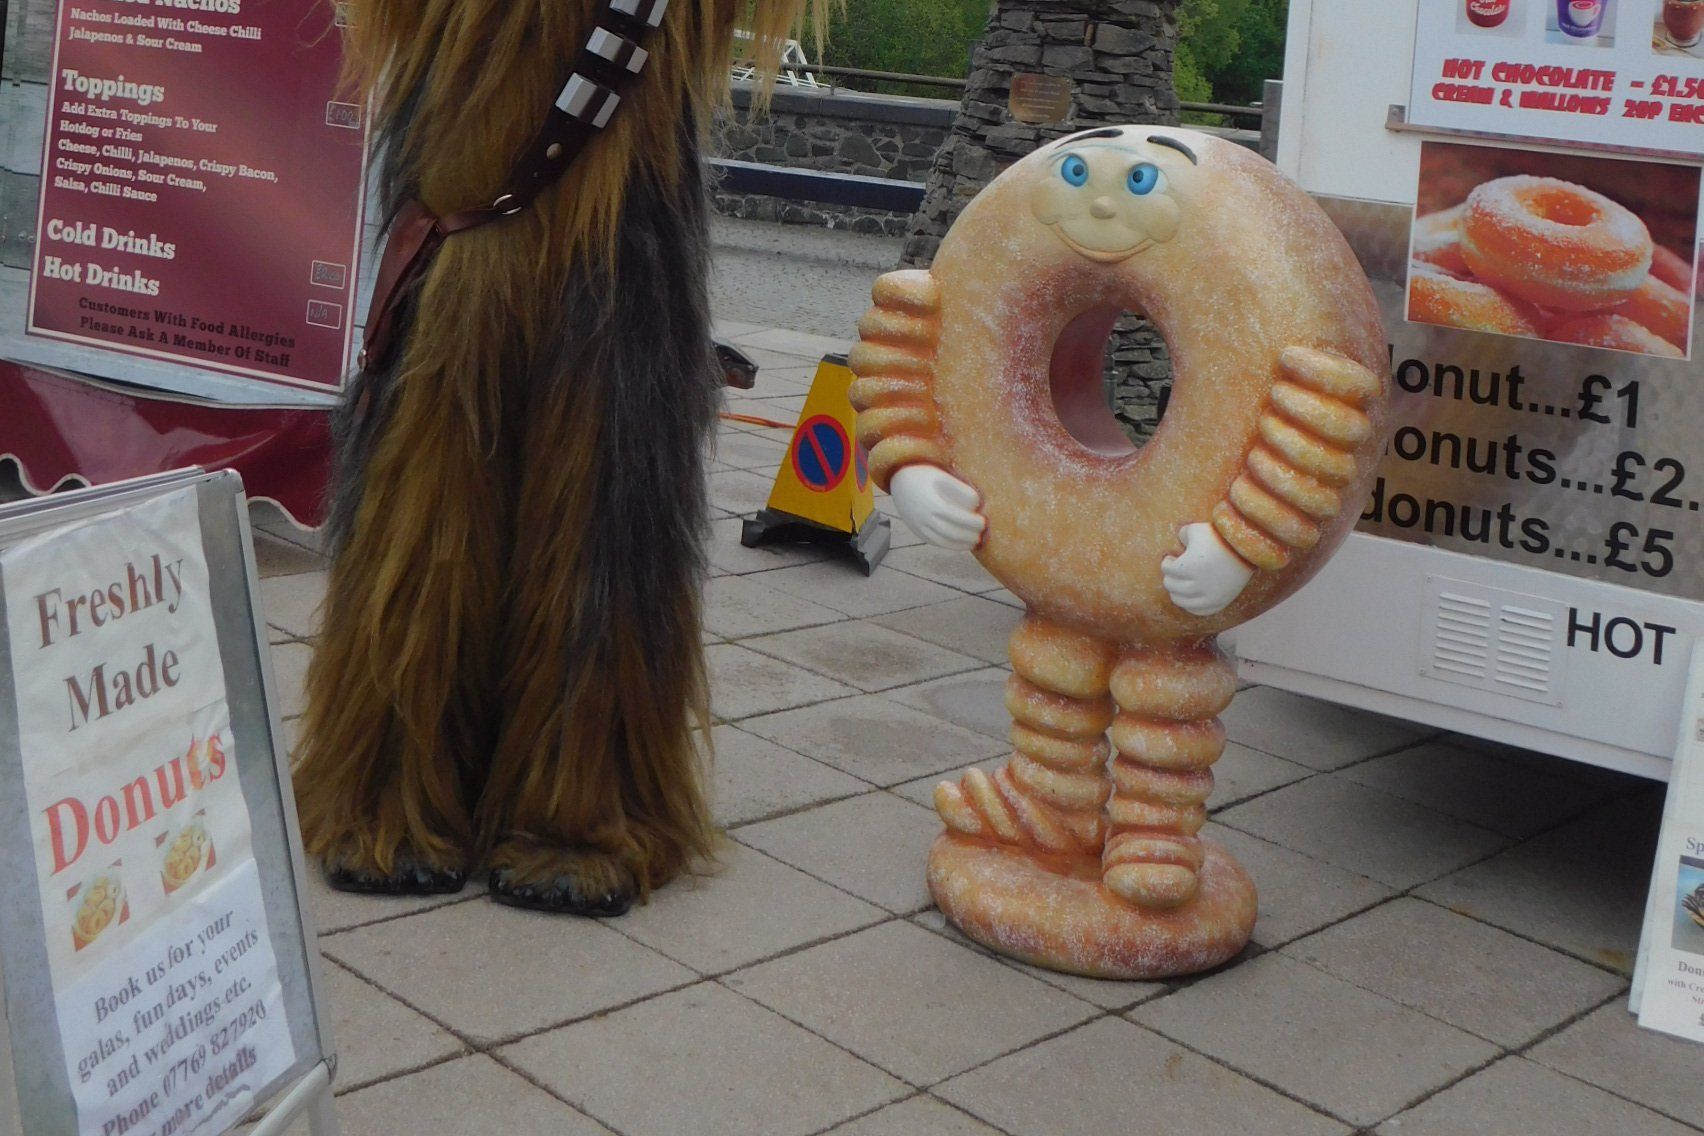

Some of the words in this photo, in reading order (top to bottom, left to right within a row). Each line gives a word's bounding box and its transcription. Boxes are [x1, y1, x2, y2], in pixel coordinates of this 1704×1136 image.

[69, 26, 123, 44] Jalapenos
[125, 32, 134, 45] &
[136, 34, 163, 48] Sour
[166, 37, 202, 52] Cream
[71, 8, 112, 24] Nachos
[114, 12, 155, 28] Loaded
[157, 16, 184, 31] With
[187, 20, 227, 37] Cheese
[230, 24, 262, 40] Chilli
[62, 69, 165, 105] Toppings
[1441, 58, 1486, 80] HOT
[1492, 62, 1617, 92] CHOCOLATE
[61, 101, 85, 114] Add
[87, 104, 117, 120] Extra
[120, 109, 172, 128] Toppings
[175, 116, 189, 128] To
[192, 119, 218, 133] Your
[1432, 83, 1495, 105] CREAM
[1500, 89, 1513, 109] &
[1519, 91, 1612, 116] MALLOWS
[60, 120, 99, 138] Hotdog
[101, 126, 113, 137] or
[115, 127, 143, 142] Fries
[56, 157, 93, 175] Crispy
[94, 162, 136, 181] Onions,
[138, 169, 165, 184] Sour
[167, 174, 207, 192] Cream,
[58, 138, 100, 157] Cheese,
[102, 145, 136, 162] Chilli,
[137, 150, 198, 172] Jalapenos,
[199, 159, 237, 177] Crispy
[239, 165, 279, 183] Bacon,
[54, 176, 89, 193] Salsa,
[90, 181, 121, 196] Chilli
[123, 187, 158, 202] Sauce
[46, 218, 97, 247] Cold
[101, 227, 176, 260] Drinks
[43, 256, 82, 282] Hot
[86, 263, 160, 296] Drinks
[79, 297, 150, 322] Customers
[154, 309, 187, 328] With
[190, 317, 225, 335] Food
[229, 323, 296, 349] Allergies
[80, 316, 125, 336] Please
[127, 325, 155, 342] Ask
[158, 331, 169, 345] A
[172, 333, 232, 357] Member
[235, 345, 252, 361] Of
[254, 348, 291, 368] Staff
[34, 553, 184, 650] Freshly
[1566, 607, 1676, 666] HOT
[62, 643, 181, 733] Made
[42, 731, 227, 878] Donuts
[94, 976, 143, 1024] Book
[145, 961, 166, 986] us
[167, 939, 194, 969] for
[197, 910, 234, 954] your
[1668, 978, 1686, 989] with
[77, 1029, 131, 1083] galas,
[132, 1001, 164, 1035] fun
[167, 970, 212, 1009] days,
[214, 927, 259, 975] events
[106, 1054, 141, 1096] and
[144, 996, 221, 1065] weddings
[225, 975, 252, 1004] etc.
[101, 1090, 160, 1136] Phone
[210, 999, 267, 1056] 827920
[160, 1093, 204, 1136] more
[205, 1043, 258, 1100] details
